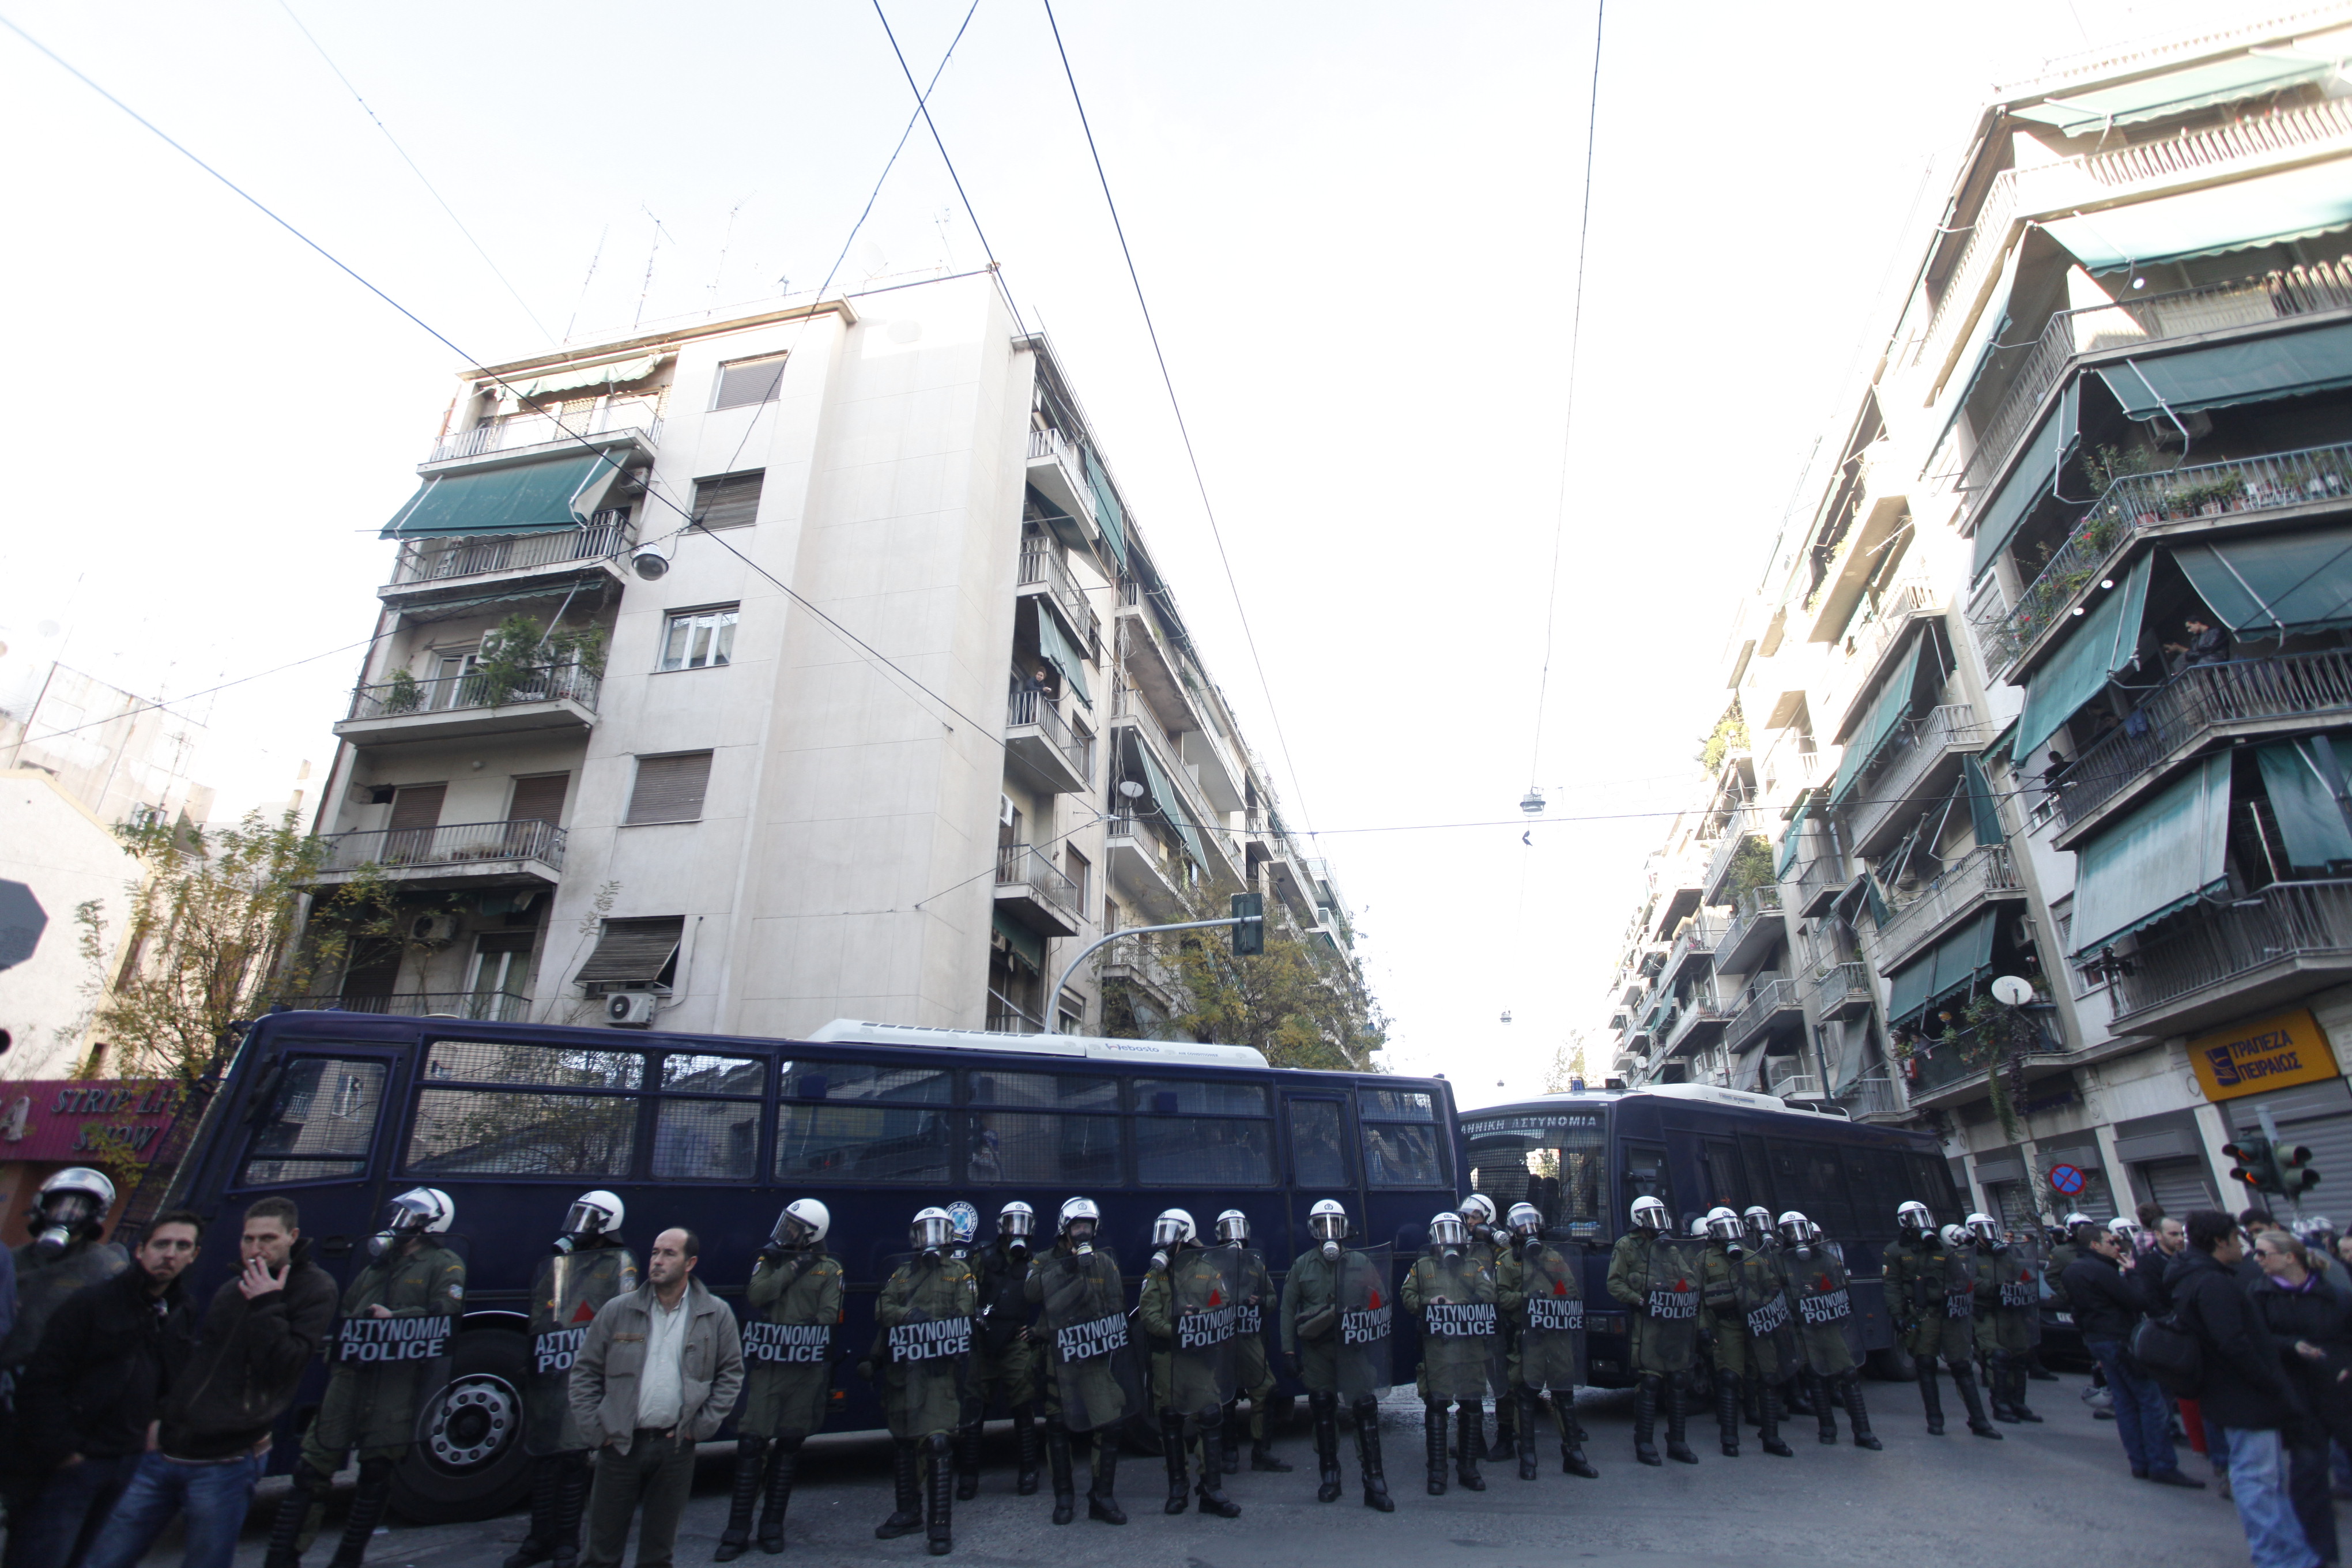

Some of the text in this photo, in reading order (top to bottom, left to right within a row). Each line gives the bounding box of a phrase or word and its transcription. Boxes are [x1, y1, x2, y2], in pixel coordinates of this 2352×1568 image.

[1105, 1043, 1160, 1053] Webasto
[2229, 1030, 2293, 1059] ΤΡΑΠΕΖΑ
[2237, 1051, 2302, 1081] ΠΕΙΡΑΙΩΣ
[51, 1089, 132, 1113] STRIP
[1512, 1116, 1596, 1129] ΑΣΤΥΝΟΜΙΑ
[1426, 1303, 1497, 1322] ΑΣΤΥΝΟΜΙΑ
[1528, 1298, 1584, 1316] ΑΣΤΥΝΟΜΙΑ
[1651, 1304, 1698, 1319] POLICE
[1800, 1288, 1849, 1313] ΑΣΤΥΝΟΜΙΑ
[1178, 1304, 1236, 1334] ΑΣΤΥΝΟΜΙΑ
[1238, 1317, 1261, 1332] ΑΣΤ
[1341, 1302, 1392, 1330] ΑΣΤΥΝΟΜΙΑ
[1531, 1314, 1582, 1329] POLICE
[1804, 1302, 1851, 1324] POLICE
[339, 1315, 451, 1341] ΑΣΤΥΝΟΜΙΑ
[742, 1321, 830, 1345] ΑΣΤΥΝΟΜΙΑ
[888, 1316, 973, 1347] ΑΣΤΥΝΟΜΙΑ
[1057, 1311, 1128, 1348] ΑΣΤΥΝΟΜΙΑ
[1182, 1321, 1235, 1348] POLICE
[1345, 1320, 1392, 1344] POLICE
[1430, 1321, 1495, 1335] POLICE
[340, 1338, 444, 1360] POLICE
[744, 1341, 824, 1362] POLICE
[893, 1336, 970, 1363] POLICE
[1062, 1330, 1128, 1363] POLICE
